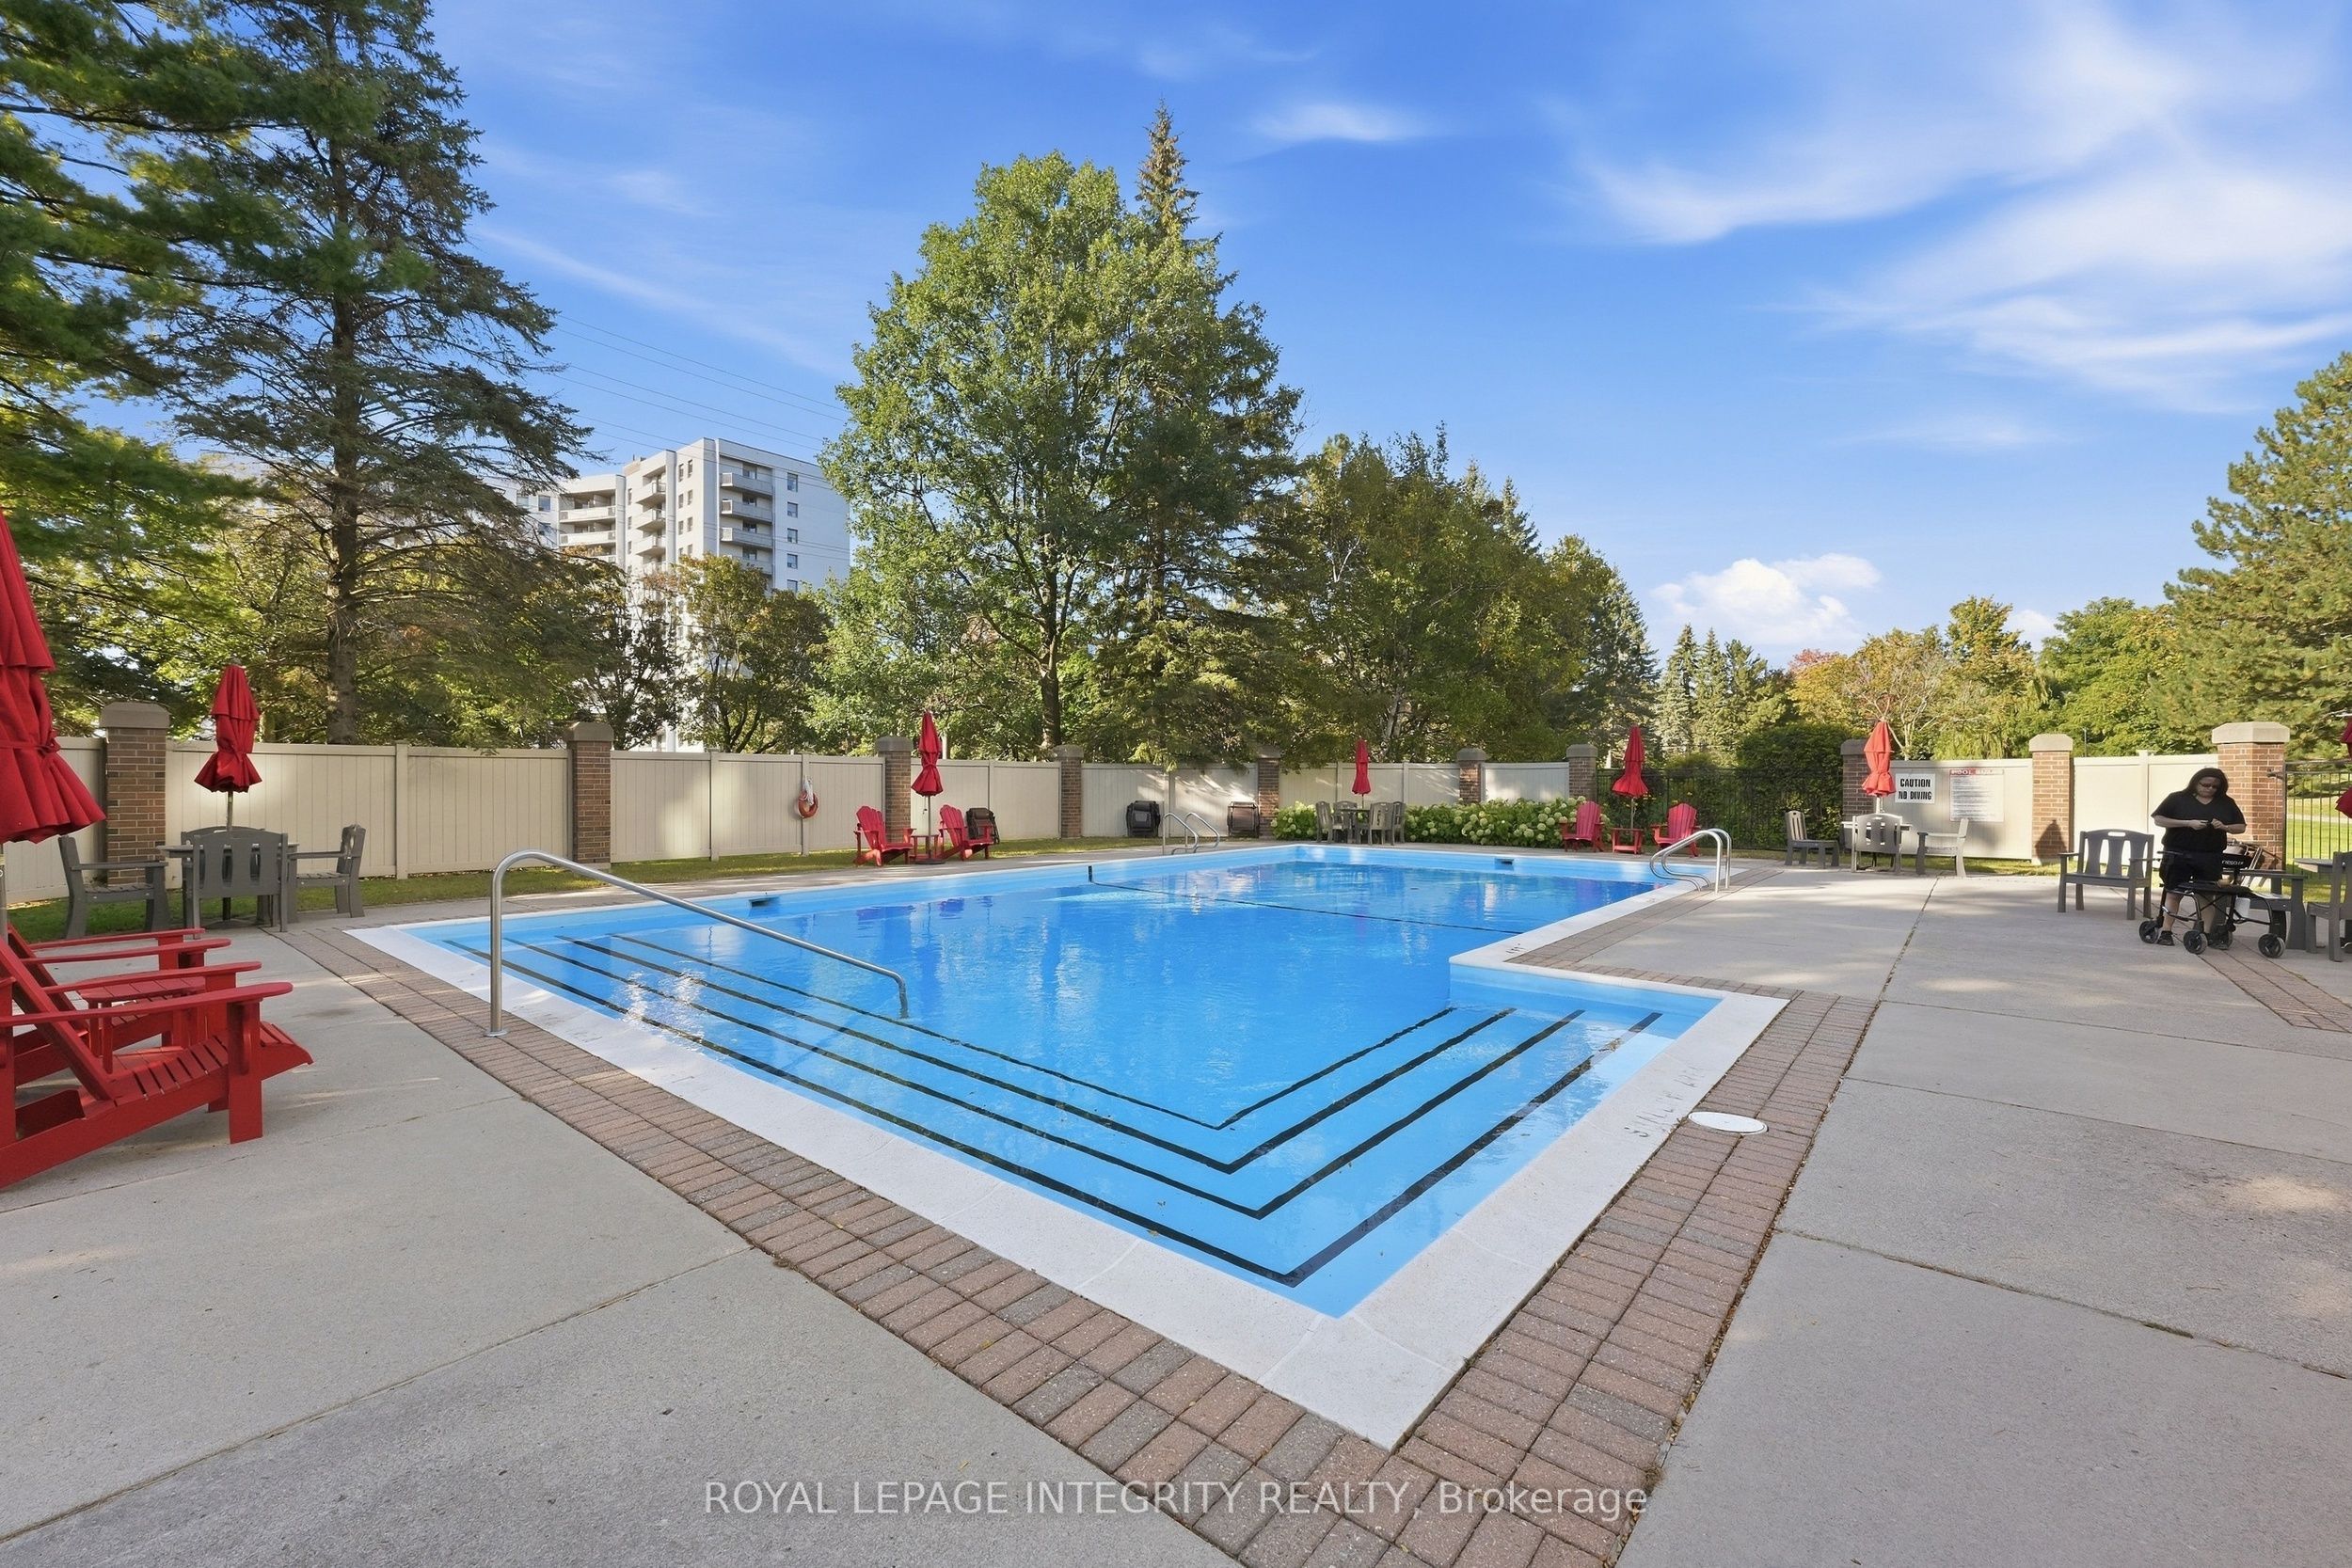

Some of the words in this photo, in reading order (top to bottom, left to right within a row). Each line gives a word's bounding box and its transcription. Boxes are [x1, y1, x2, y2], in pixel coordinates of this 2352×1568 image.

[1900, 778, 1931, 787] CAUTION
[1898, 791, 1908, 800] NO
[1910, 791, 1932, 800] DIVING
